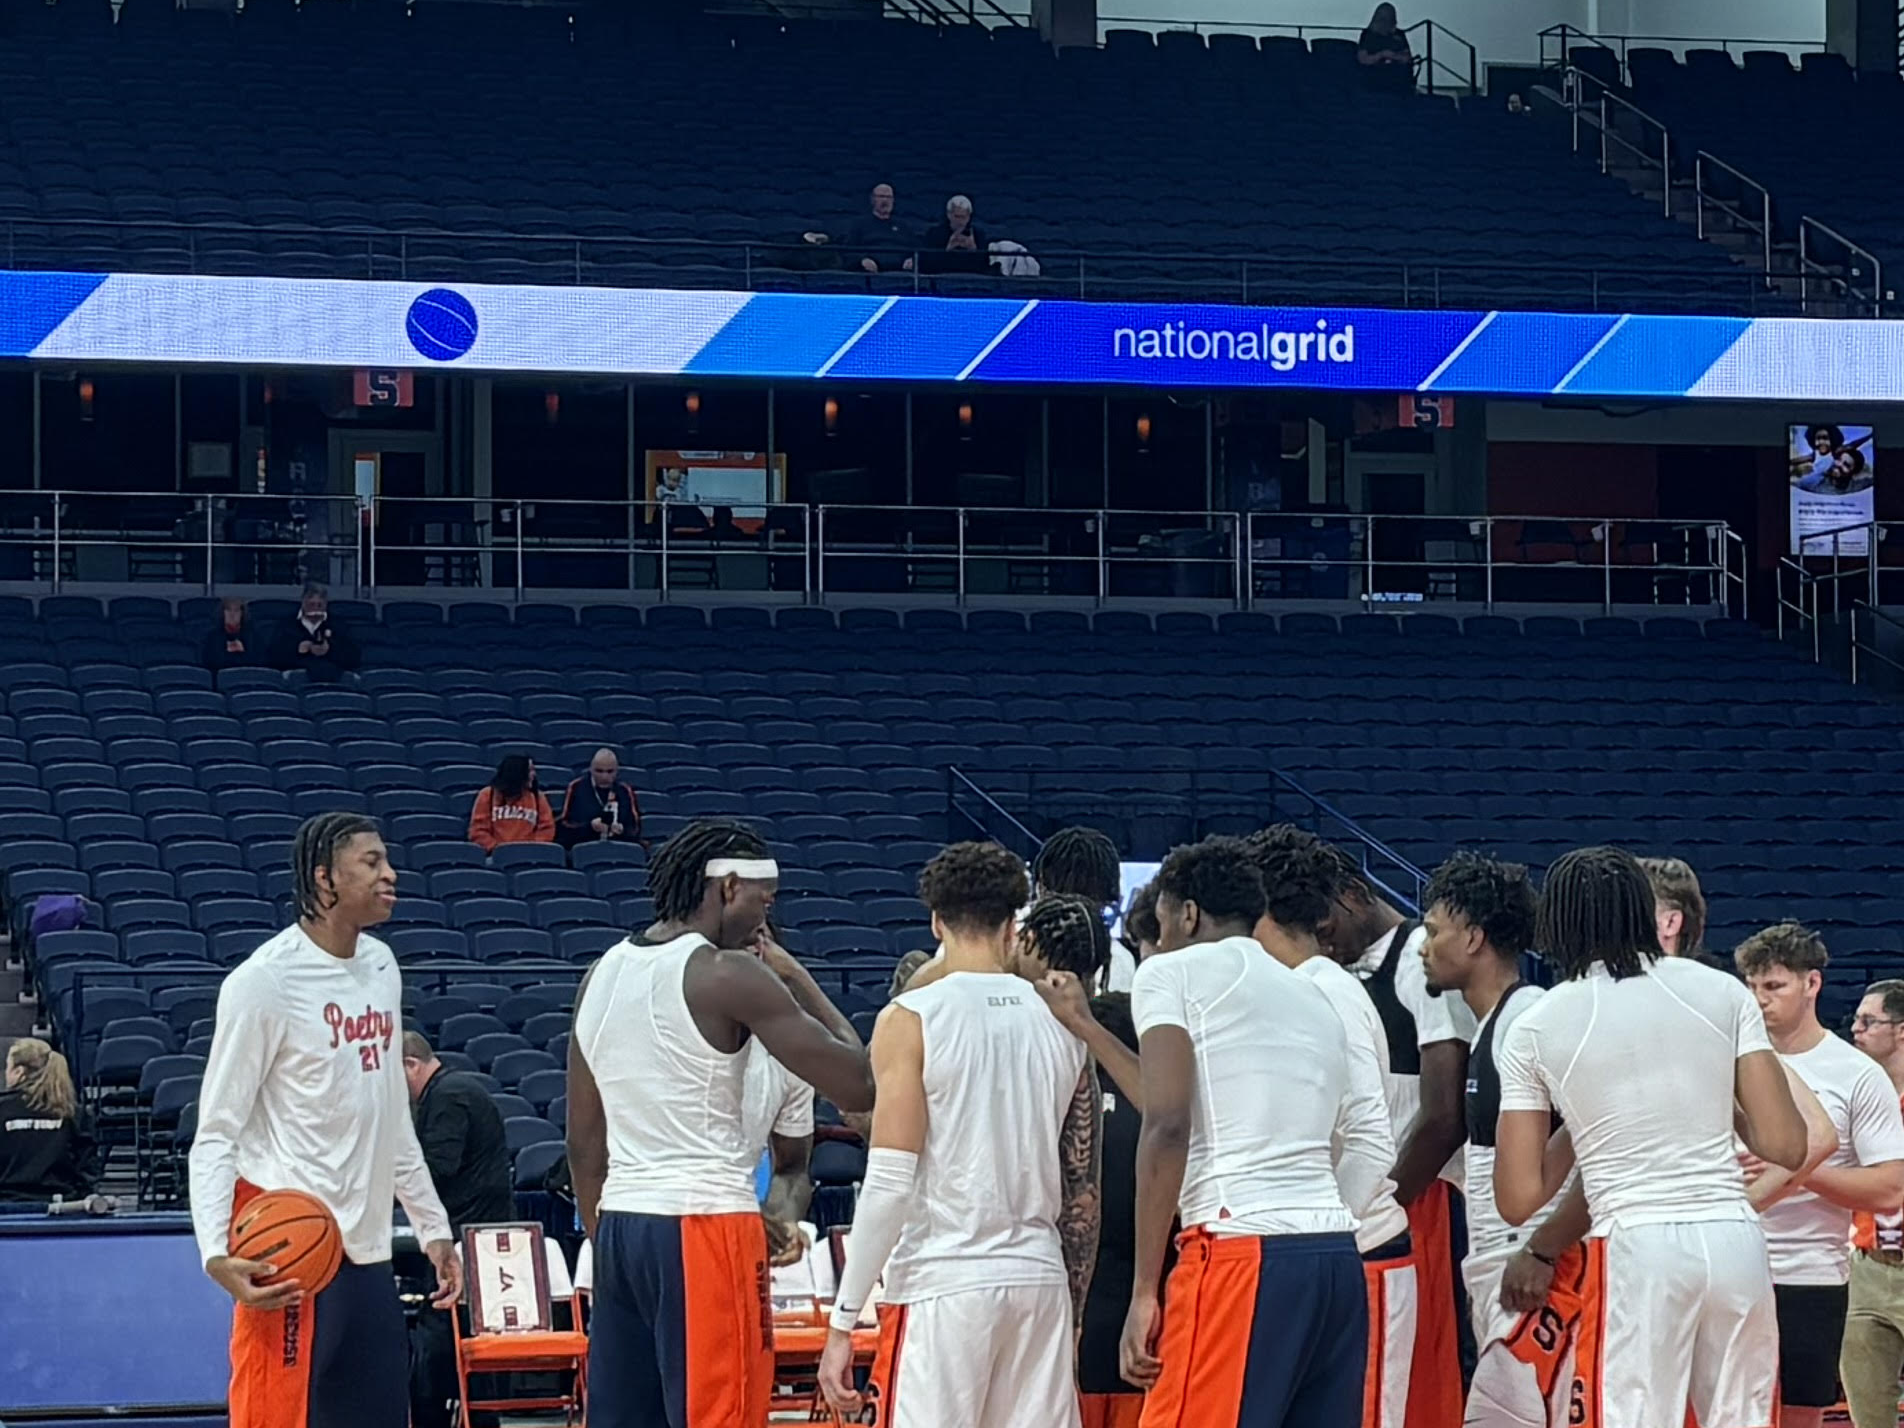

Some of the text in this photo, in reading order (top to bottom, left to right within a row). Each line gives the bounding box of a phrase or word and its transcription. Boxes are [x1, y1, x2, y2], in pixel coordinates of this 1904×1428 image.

[1112, 318, 1354, 370] nationalgrid
[324, 1002, 394, 1050] Poetry
[359, 1044, 381, 1072] 21
